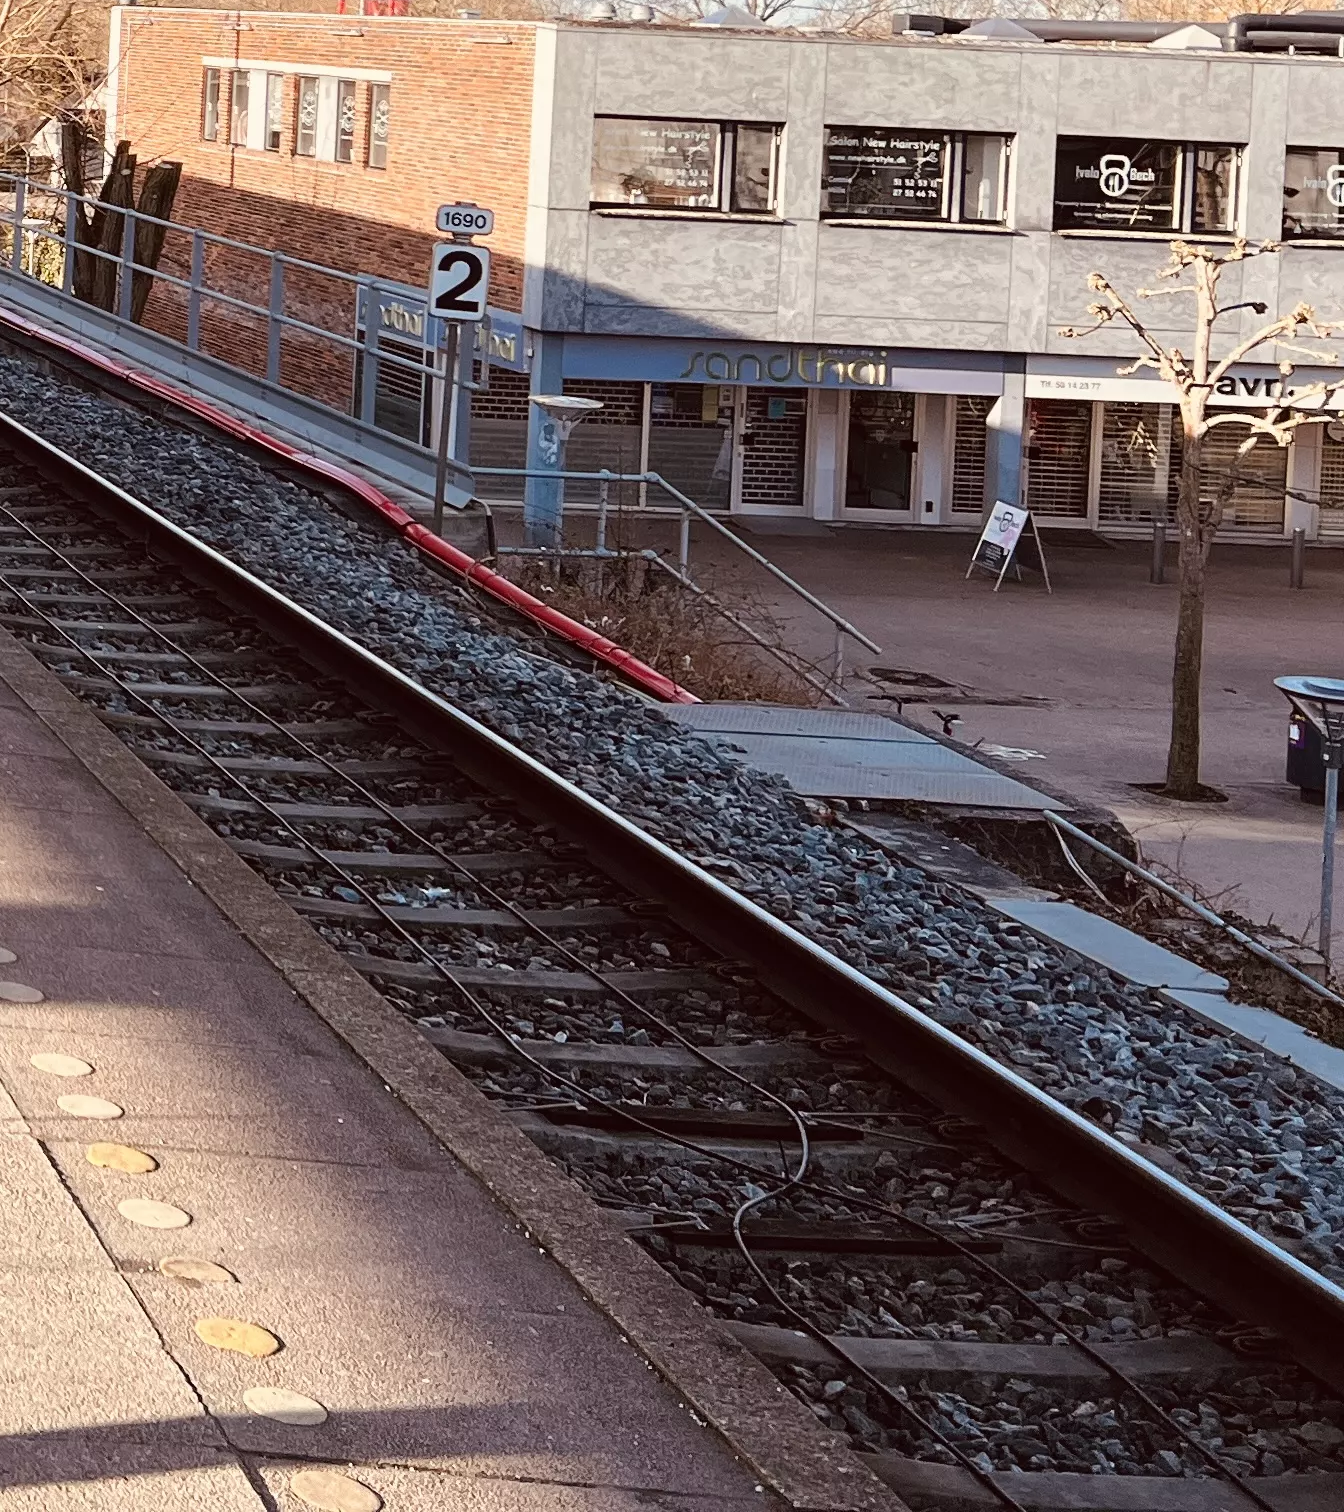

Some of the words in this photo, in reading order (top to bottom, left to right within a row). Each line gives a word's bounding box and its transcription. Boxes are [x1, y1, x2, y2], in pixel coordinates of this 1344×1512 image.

[829, 135, 860, 147] Salon
[862, 137, 887, 148] New
[890, 138, 941, 153] Hairstyle
[1075, 165, 1101, 179] Ivalo
[1129, 167, 1155, 182] Bech
[444, 212, 487, 229] 1690
[435, 250, 483, 313] 2
[679, 347, 888, 387] sandthai
